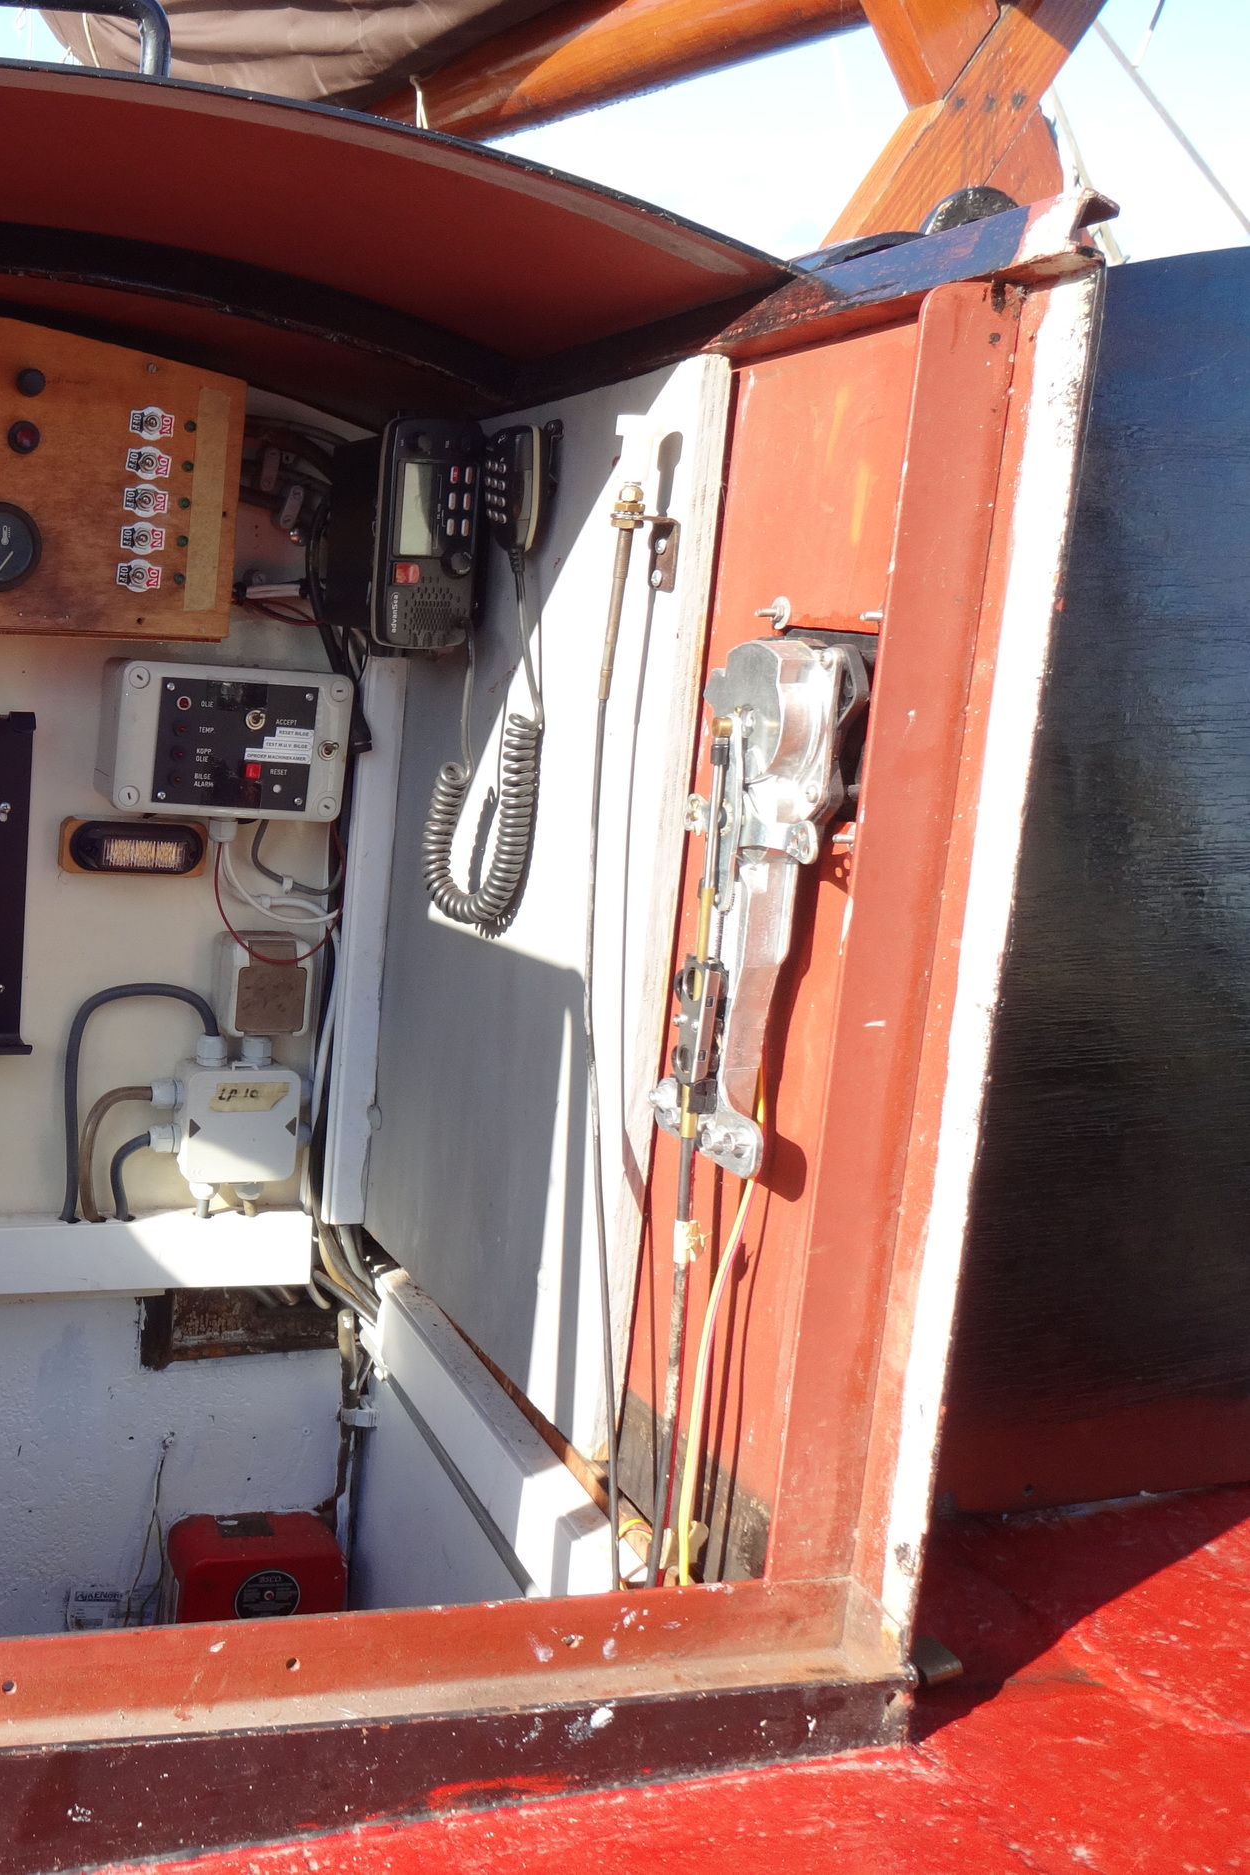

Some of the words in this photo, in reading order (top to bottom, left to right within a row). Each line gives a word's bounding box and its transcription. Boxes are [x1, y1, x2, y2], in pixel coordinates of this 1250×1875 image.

[133, 414, 141, 431] OFF
[162, 417, 171, 434] ON
[129, 452, 138, 470] OFF
[158, 458, 168, 475] ON
[126, 491, 135, 509] OFF
[155, 494, 165, 511] ON
[123, 529, 133, 547] OFF
[152, 531, 162, 548] ON
[119, 567, 129, 584] OFF
[148, 570, 159, 587] ON
[391, 595, 399, 633] advanSea
[196, 755, 208, 763] OLIE
